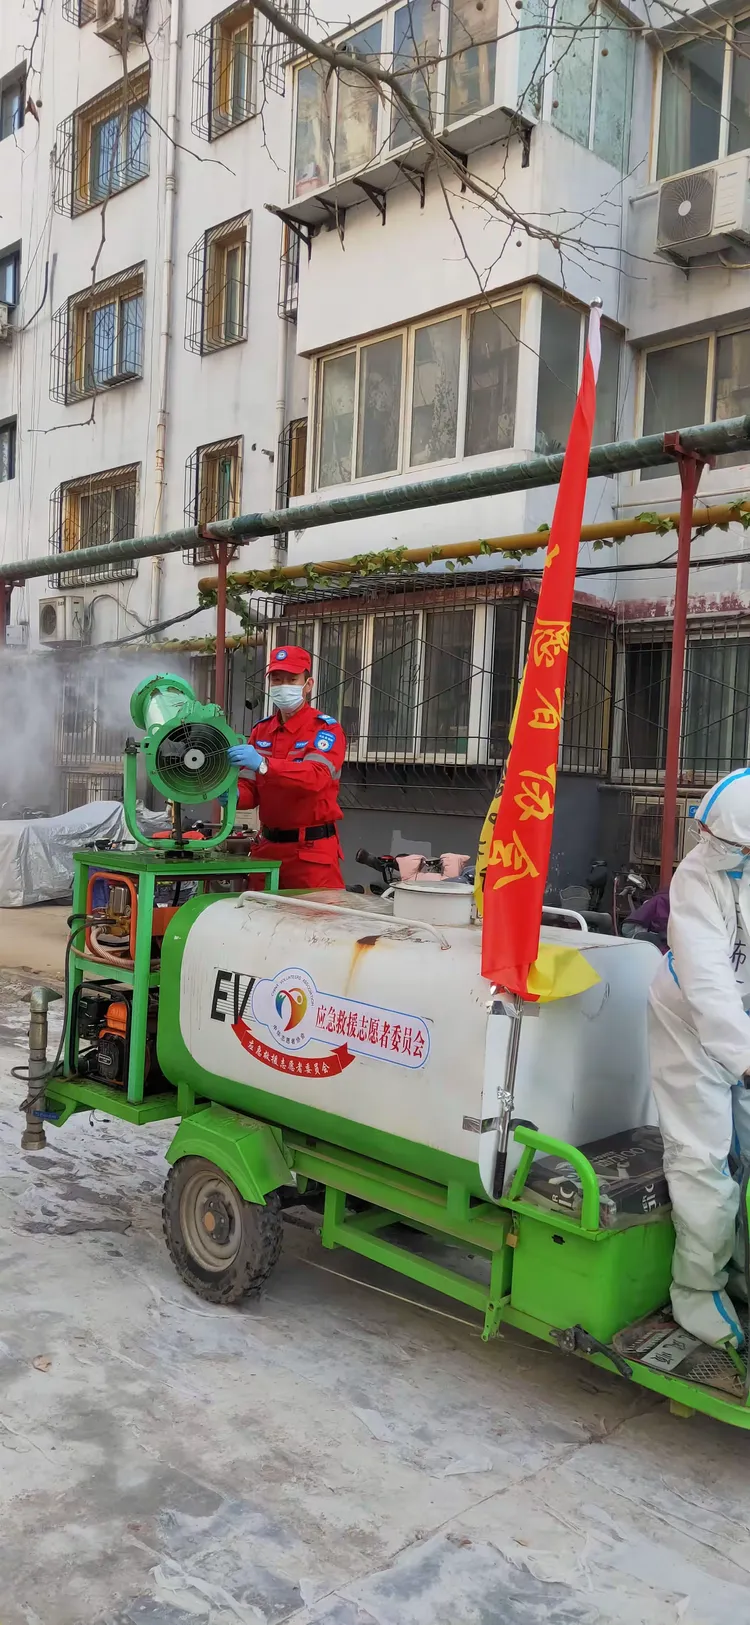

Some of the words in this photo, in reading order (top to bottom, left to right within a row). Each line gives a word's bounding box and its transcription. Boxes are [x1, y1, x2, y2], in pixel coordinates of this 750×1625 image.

[488, 544, 571, 890] 愿者协会
[211, 969, 256, 1025] EV
[247, 1039, 331, 1076] 应急救援志愿者委员会
[314, 1004, 426, 1059] 应急救援志愿者委员会
